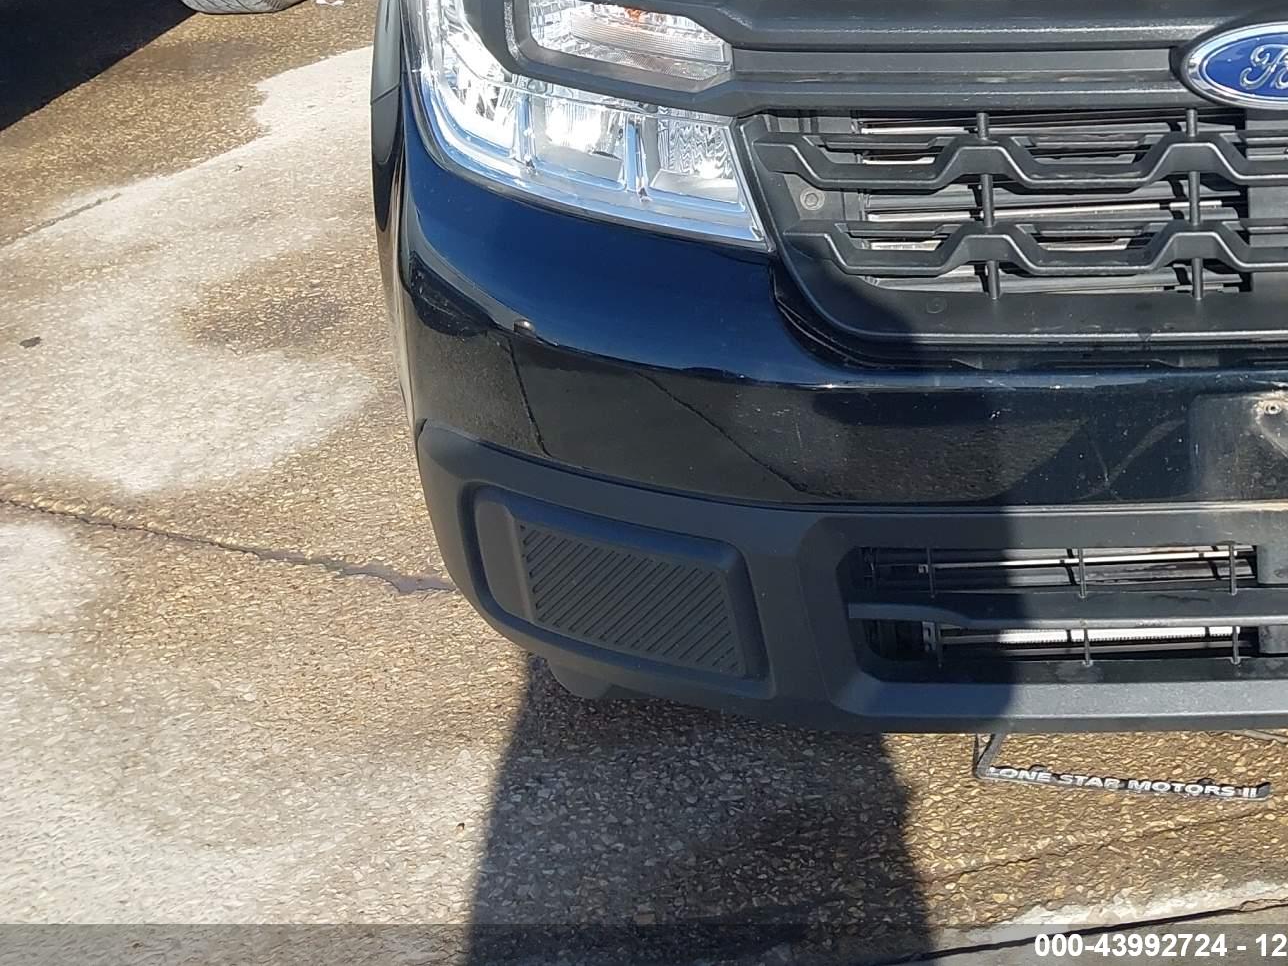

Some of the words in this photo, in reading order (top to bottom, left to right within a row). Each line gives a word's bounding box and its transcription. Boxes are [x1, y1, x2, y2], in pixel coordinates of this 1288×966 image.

[987, 766, 1052, 783] LONE
[1057, 774, 1121, 790] STAR
[1127, 779, 1236, 797] MOTORS
